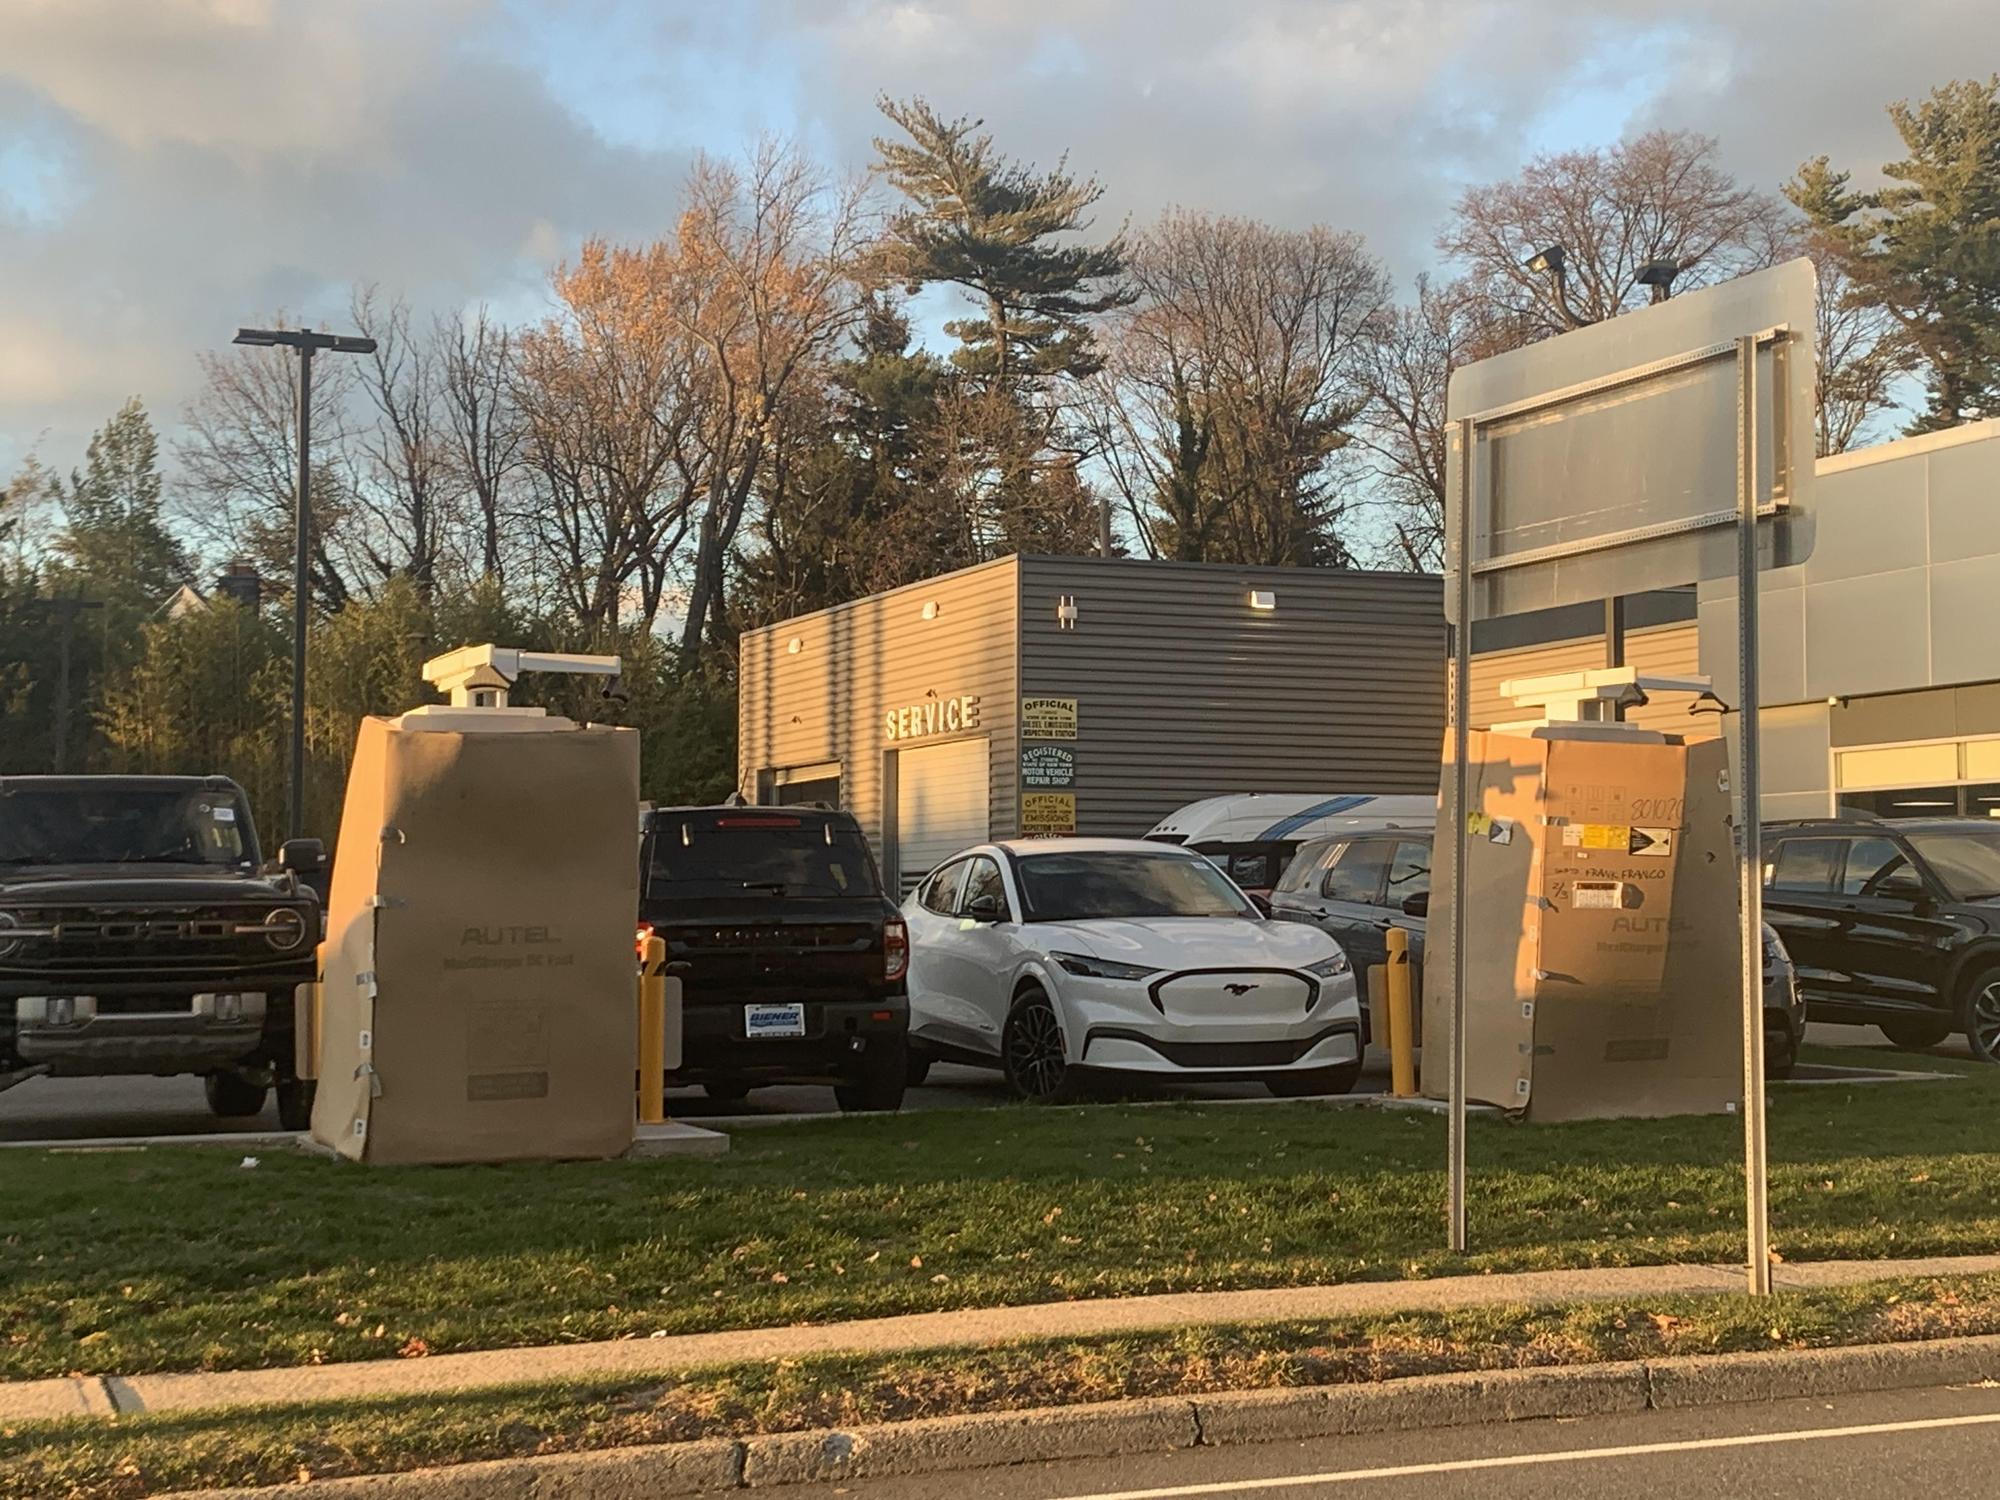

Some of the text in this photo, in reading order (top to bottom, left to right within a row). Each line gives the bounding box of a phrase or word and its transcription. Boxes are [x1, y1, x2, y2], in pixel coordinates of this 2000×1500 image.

[1024, 700, 1074, 712] OFFICIAL
[886, 695, 977, 740] SERVICE
[1022, 746, 1073, 762] REGISTERED
[1022, 768, 1073, 776] MOTOR VEHICLE
[1026, 776, 1070, 785] REPAIR SHOP
[1024, 795, 1071, 808] OFFICIAL
[1025, 814, 1070, 822] EMISSIONS
[1621, 868, 1666, 880] FRANCO
[461, 926, 563, 946] AUTEL
